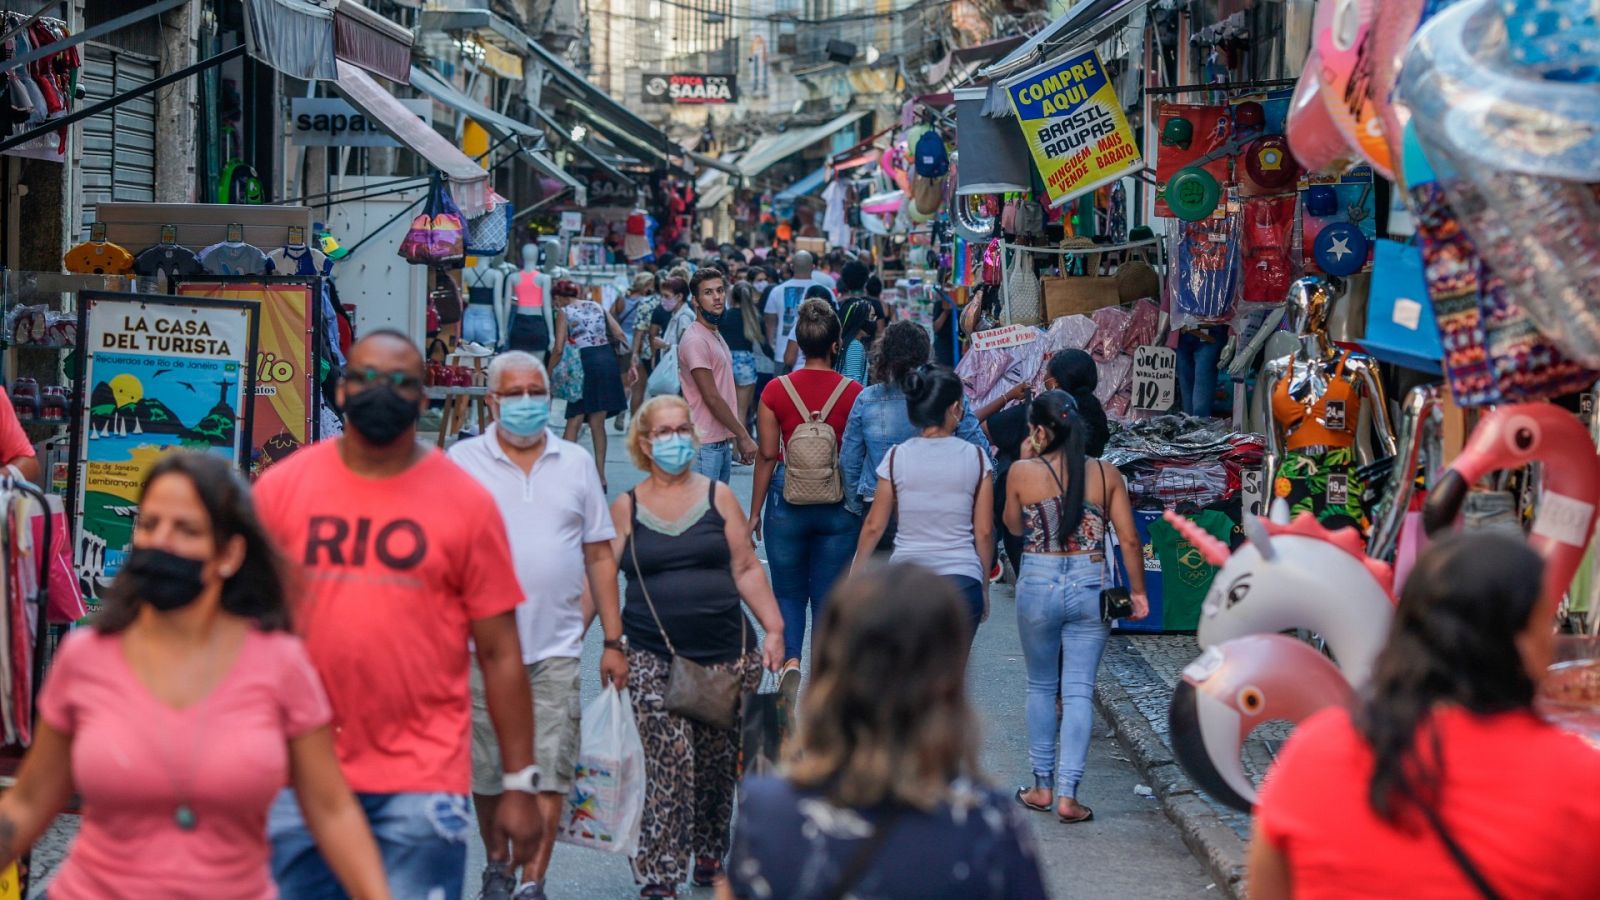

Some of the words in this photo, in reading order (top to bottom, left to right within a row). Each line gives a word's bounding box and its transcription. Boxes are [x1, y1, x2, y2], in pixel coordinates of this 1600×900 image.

[669, 83, 731, 99] SAARA
[1019, 59, 1097, 105] COMPRE
[1042, 84, 1088, 117] AQUI
[1037, 105, 1110, 143] BRASIL
[1044, 117, 1116, 159] ROUPAS
[1047, 145, 1092, 188] NINGUÉM
[1097, 131, 1122, 153] MAIS
[1058, 163, 1089, 192] VENDE
[1095, 143, 1134, 169] BARATO
[102, 332, 140, 349] DEL
[145, 335, 231, 356] TURISTA
[124, 316, 149, 332] LA
[155, 318, 212, 336] CASA
[95, 354, 141, 367] Recuerdos
[142, 358, 155, 367] de
[157, 358, 171, 367] Rio
[187, 361, 218, 371] Janeiro
[304, 515, 428, 571] RIO
